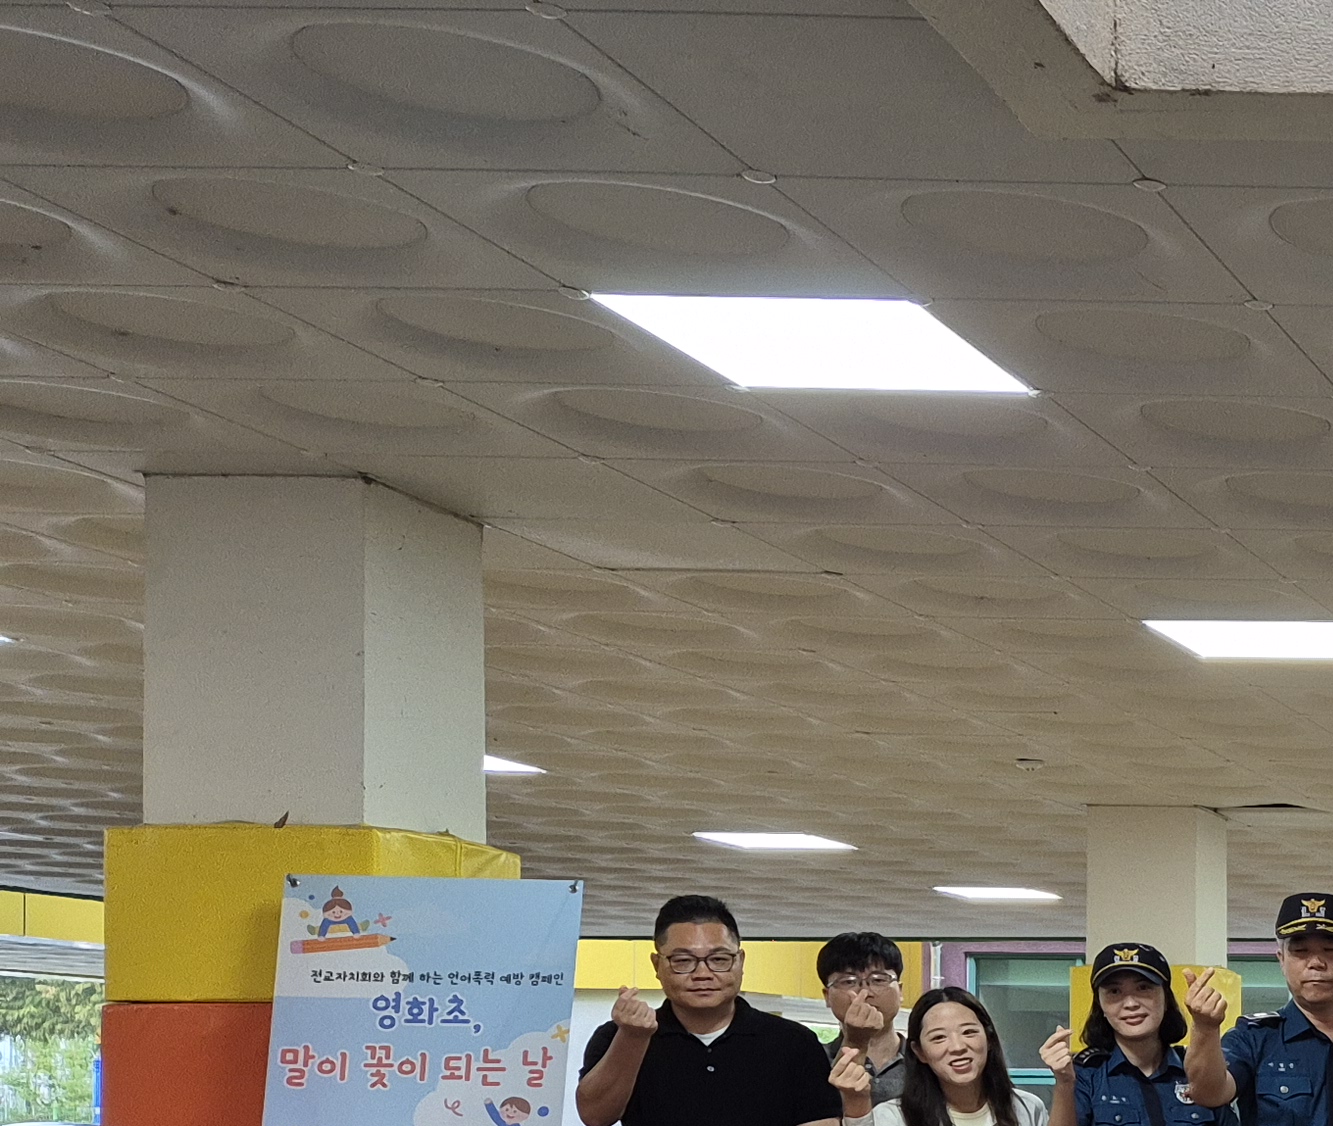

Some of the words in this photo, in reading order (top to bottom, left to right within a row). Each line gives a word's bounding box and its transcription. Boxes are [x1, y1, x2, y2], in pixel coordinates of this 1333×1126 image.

[310, 970, 385, 983] 전교자치회와
[389, 970, 414, 984] 함께
[419, 972, 443, 984] 하는
[447, 972, 495, 985] 언어폭력
[499, 973, 523, 986] 예방
[529, 972, 564, 986] 캠페인
[371, 990, 481, 1034] 영화초,
[279, 1045, 347, 1087] 말이
[363, 1045, 427, 1088] 꽃이
[441, 1048, 506, 1086] 되는
[521, 1048, 552, 1087] 날
